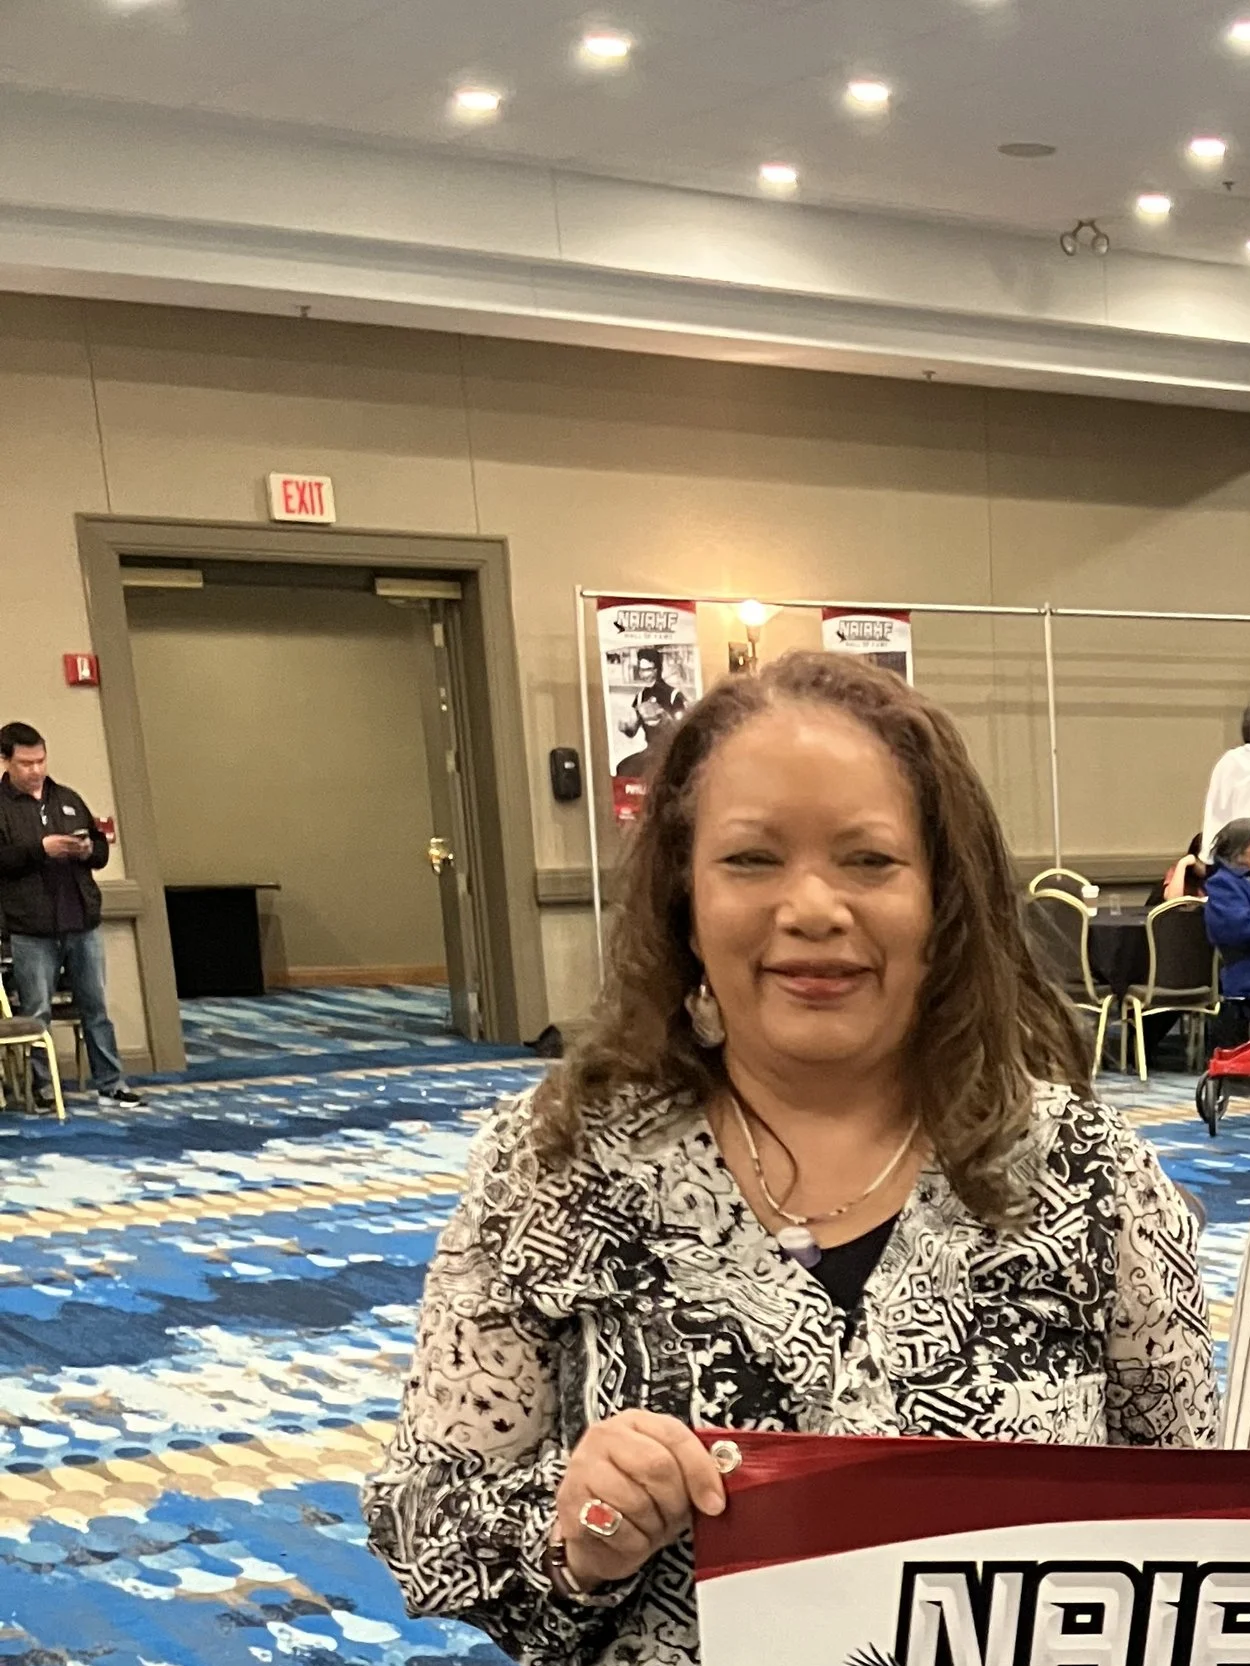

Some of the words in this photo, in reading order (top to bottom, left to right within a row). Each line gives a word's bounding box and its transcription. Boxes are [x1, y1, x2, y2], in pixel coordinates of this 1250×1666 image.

[283, 480, 324, 516] EXIT
[617, 610, 678, 632] NAIAHF
[839, 620, 893, 641] NAIAHF
